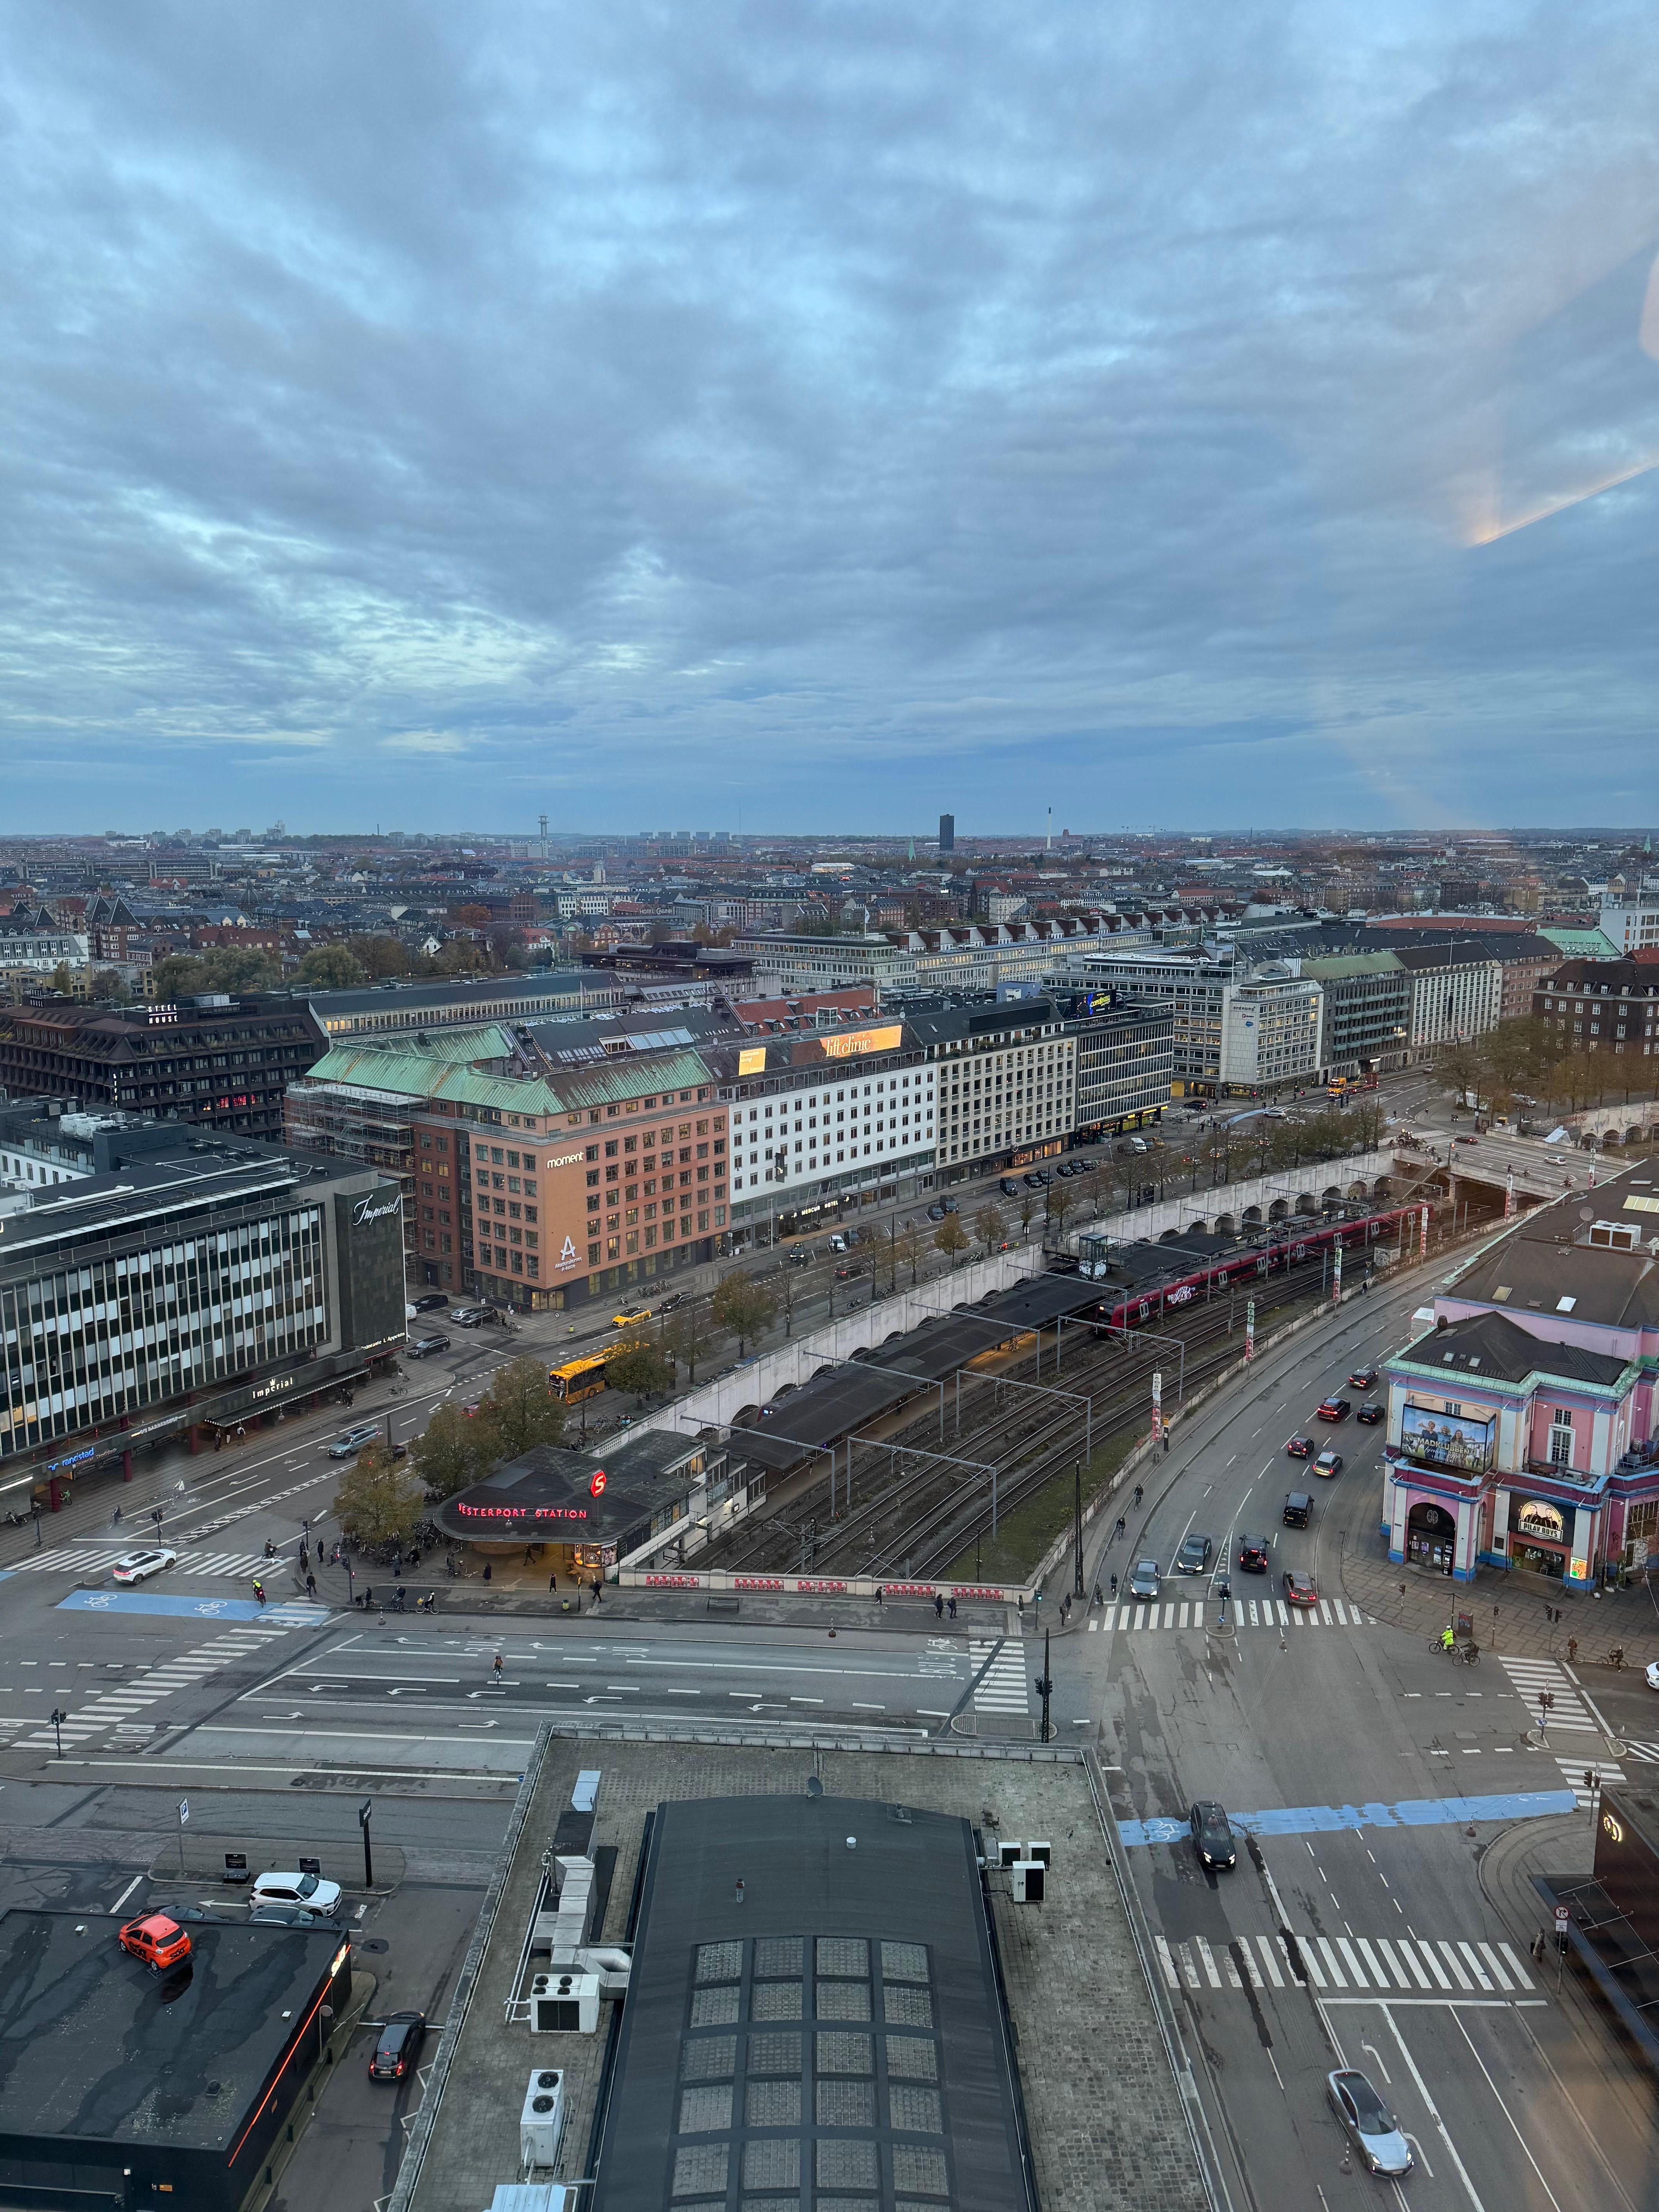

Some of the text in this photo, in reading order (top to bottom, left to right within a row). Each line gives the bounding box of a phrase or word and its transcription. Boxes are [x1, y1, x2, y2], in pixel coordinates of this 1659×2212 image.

[148, 1004, 177, 1013] STEEL
[149, 1015, 178, 1024] HOUSE
[826, 1034, 871, 1057] lift clinic
[547, 1151, 584, 1169] moment
[352, 1194, 401, 1226] Imperial
[801, 1200, 839, 1216] MERCUR HOTEL
[252, 1377, 293, 1399] Imperial
[1417, 1437, 1470, 1455] MADKLUBBEN
[62, 1447, 94, 1467] randstad
[458, 1503, 587, 1519] VESTERPORT STATION
[1523, 1523, 1558, 1538] PILAV BOYS
[464, 1635, 507, 1653] BUS
